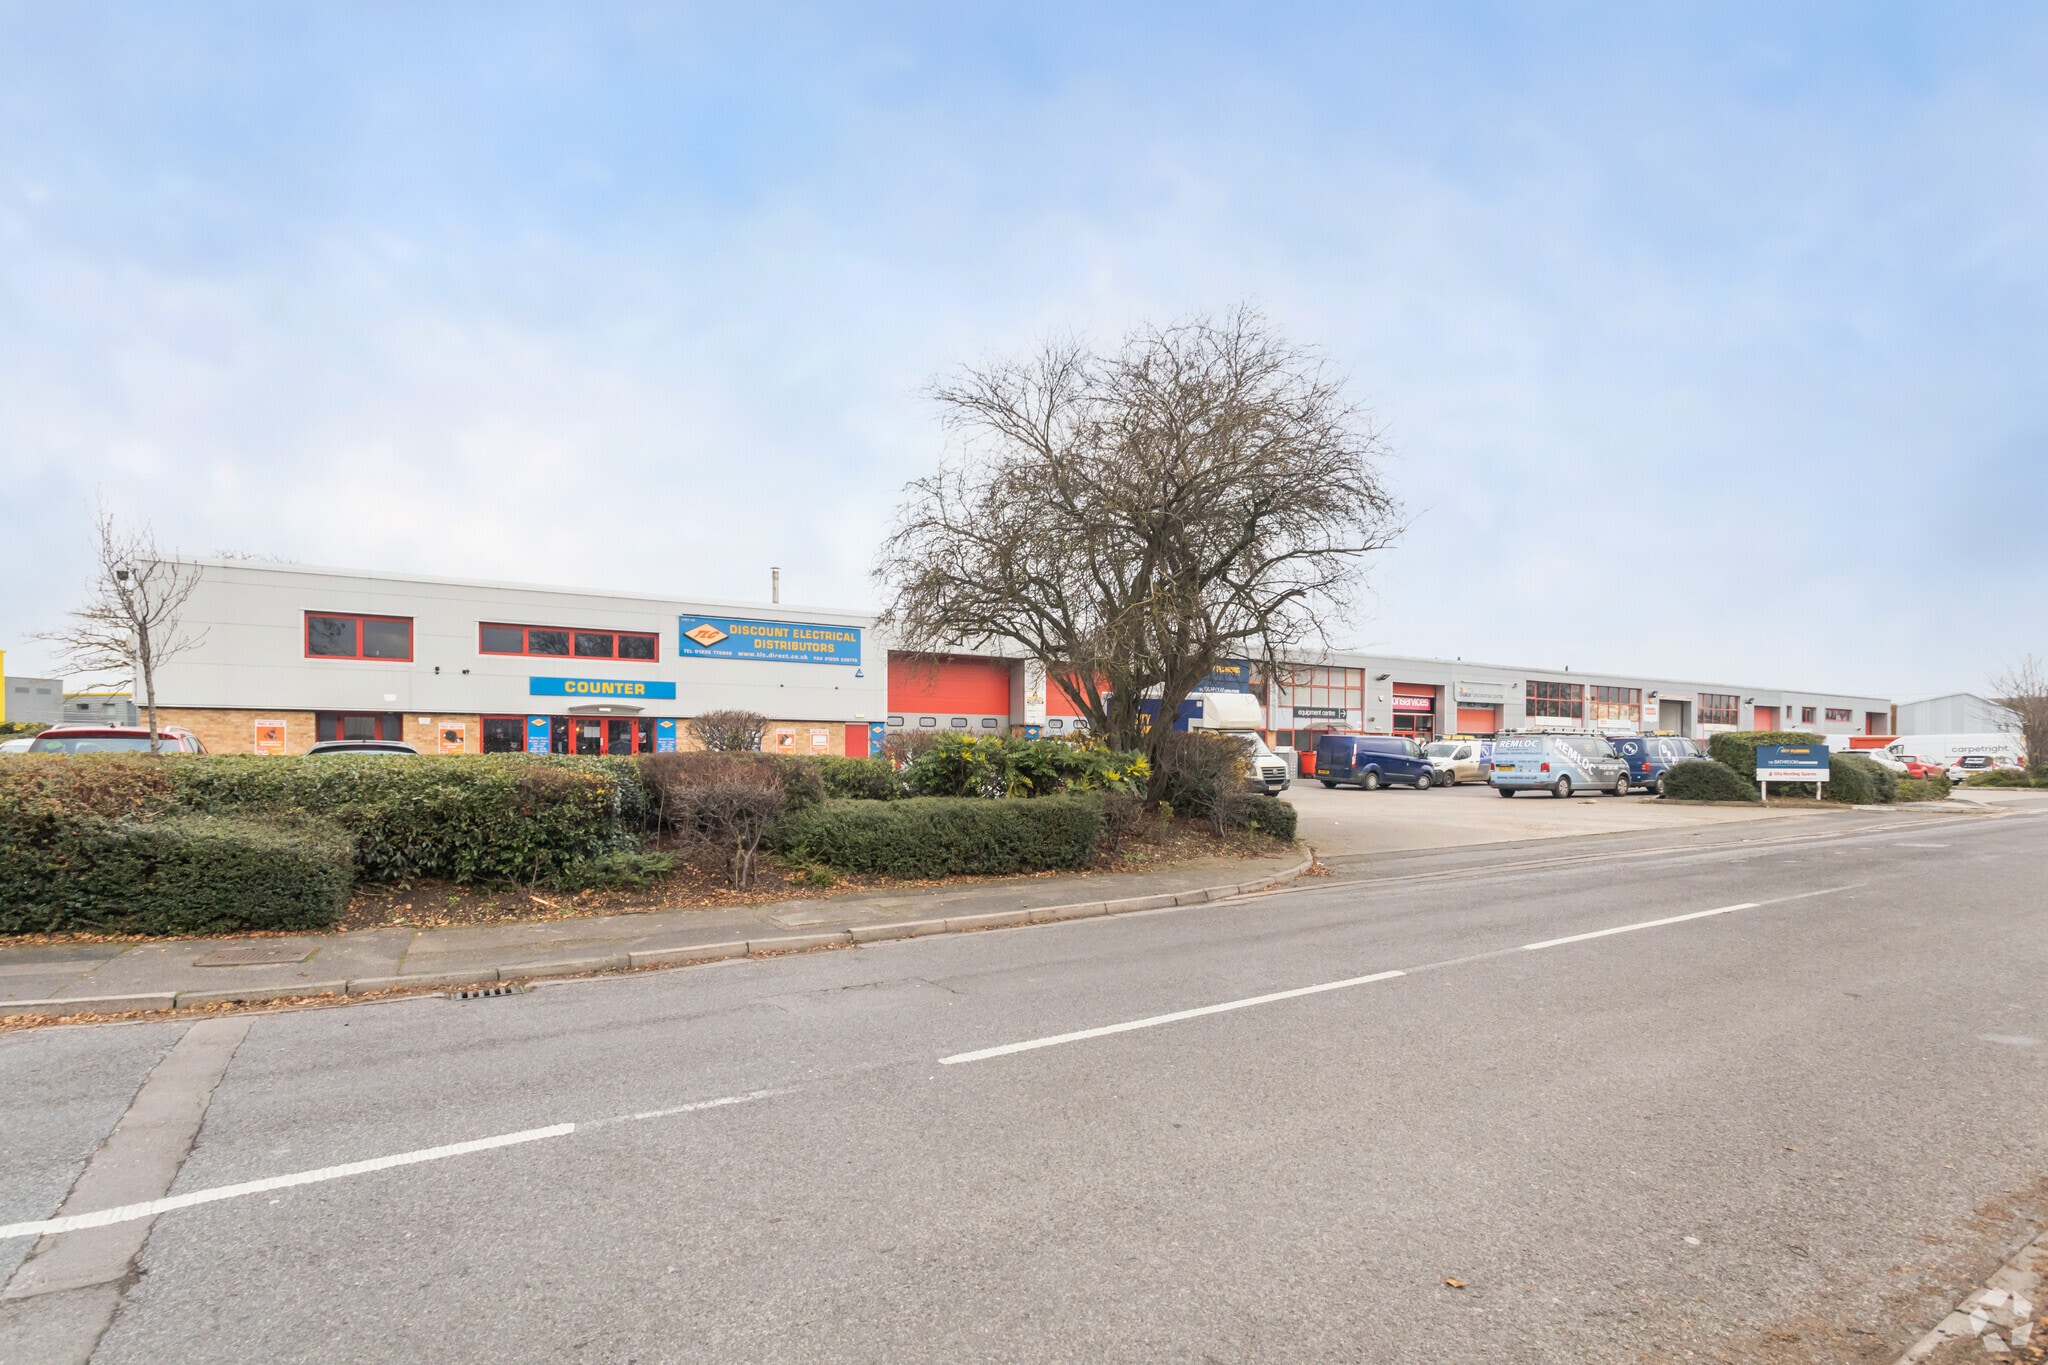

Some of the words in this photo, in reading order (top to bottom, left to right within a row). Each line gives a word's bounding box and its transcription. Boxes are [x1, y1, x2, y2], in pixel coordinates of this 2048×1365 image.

[694, 630, 720, 639] TLC
[730, 624, 789, 638] DISCOUNT
[793, 628, 857, 643] ELECTRICAL
[754, 639, 835, 653] DISTRIBUTORS
[564, 680, 645, 695] COUNTER
[1297, 709, 1321, 717] equipment
[1500, 739, 1540, 748] REMLOC
[1951, 745, 2009, 754] carpetright
[1555, 738, 1597, 776] REMLOC
